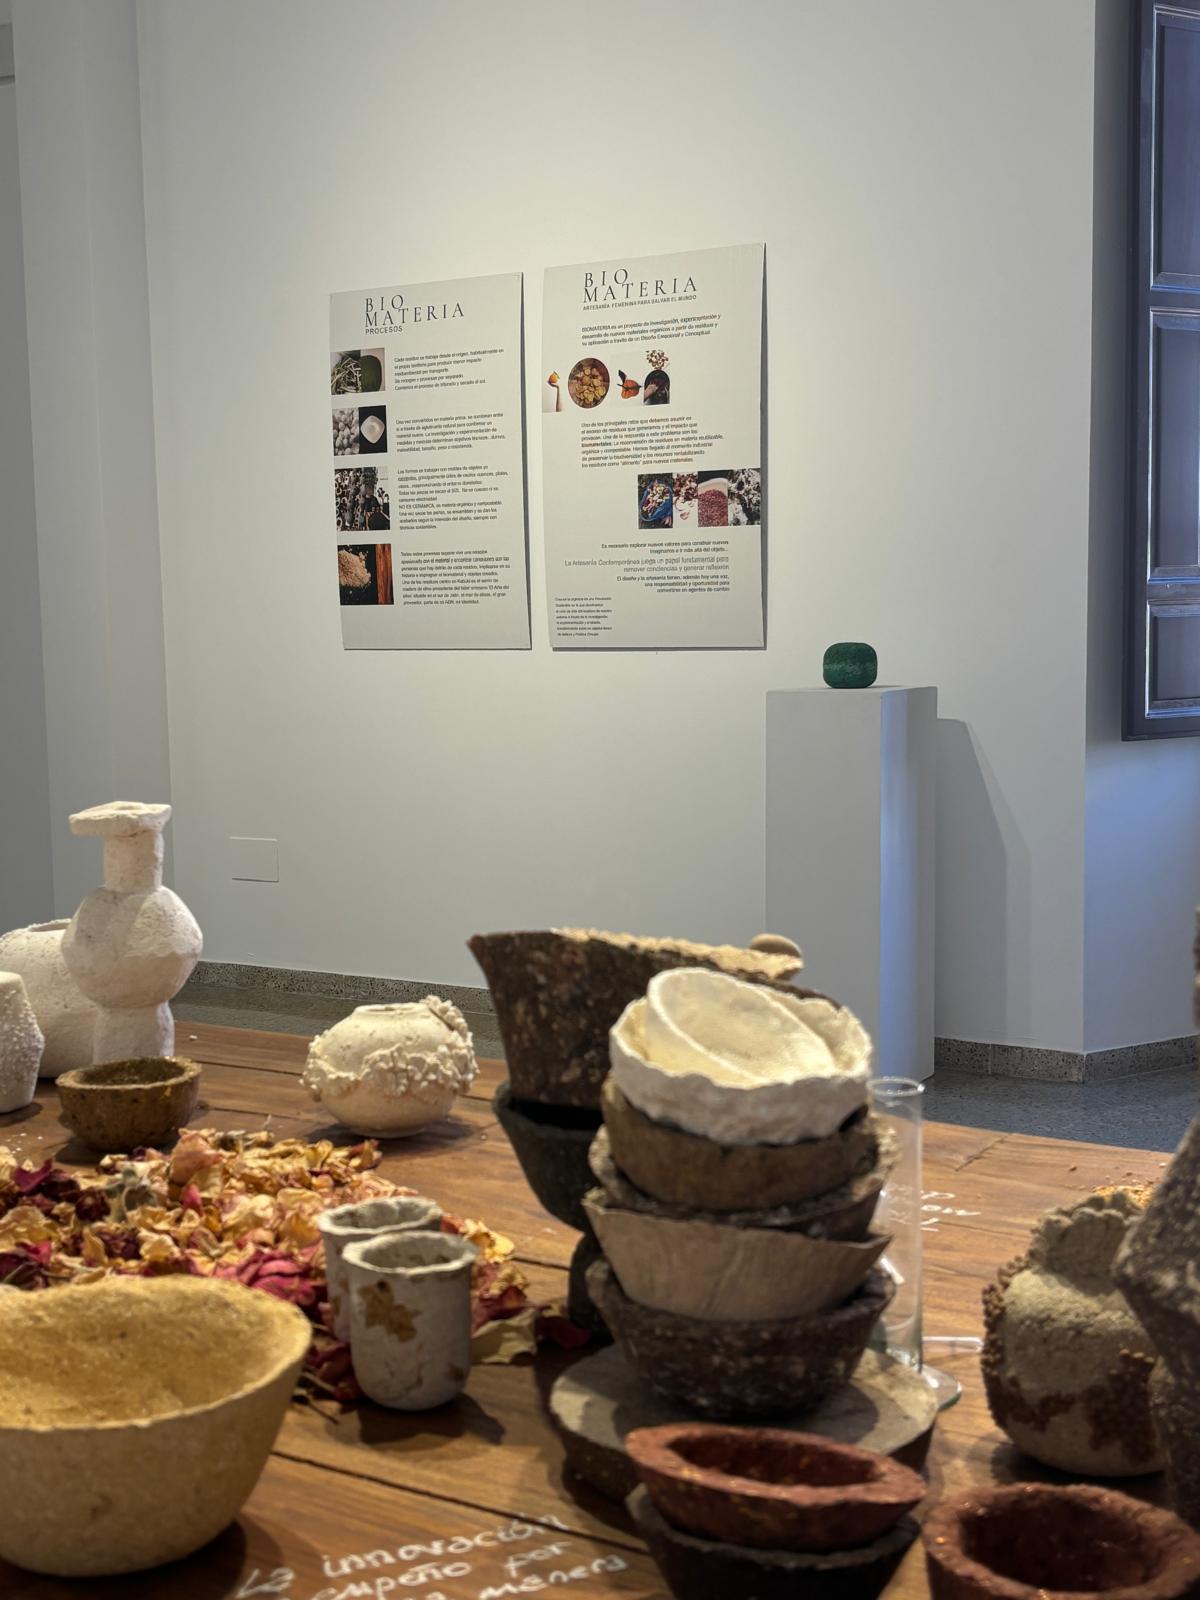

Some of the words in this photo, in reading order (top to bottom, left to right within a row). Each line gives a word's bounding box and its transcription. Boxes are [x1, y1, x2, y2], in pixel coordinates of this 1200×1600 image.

[583, 276, 697, 303] MATERIA
[584, 268, 628, 288] BIO
[366, 294, 404, 312] BIO
[366, 302, 464, 328] MATERIA
[366, 325, 403, 335] PROCESOS
[235, 1567, 294, 1599] La
[322, 1512, 569, 1579] innovación
[504, 1541, 573, 1578] por
